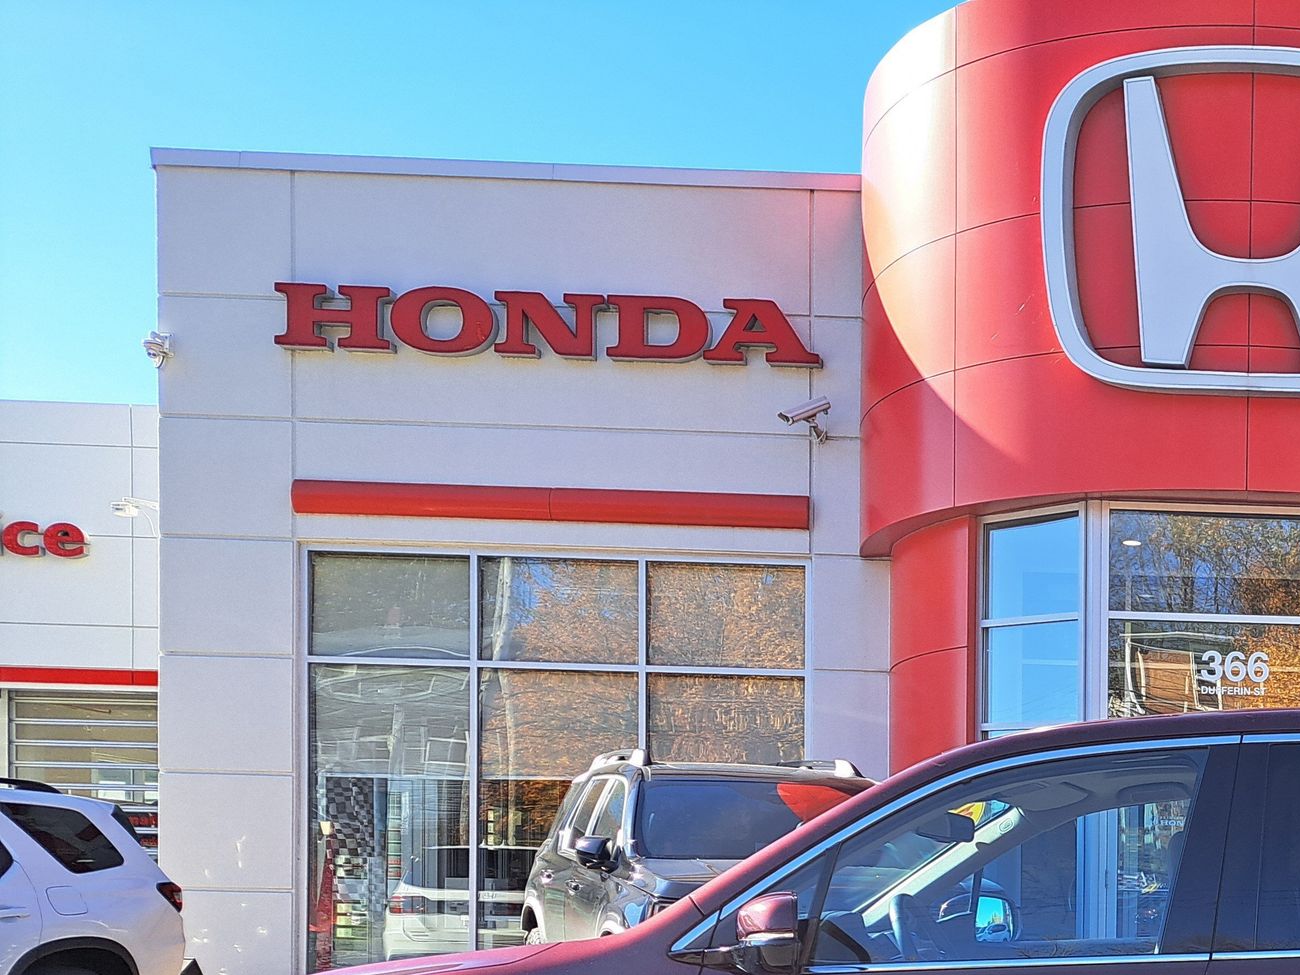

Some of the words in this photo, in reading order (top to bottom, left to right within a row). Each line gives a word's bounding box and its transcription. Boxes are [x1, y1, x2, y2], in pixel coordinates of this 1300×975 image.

[274, 282, 823, 367] HONDA
[1200, 650, 1270, 683] 366
[1200, 686, 1251, 696] DUFFERIN
[1253, 687, 1267, 696] ST
